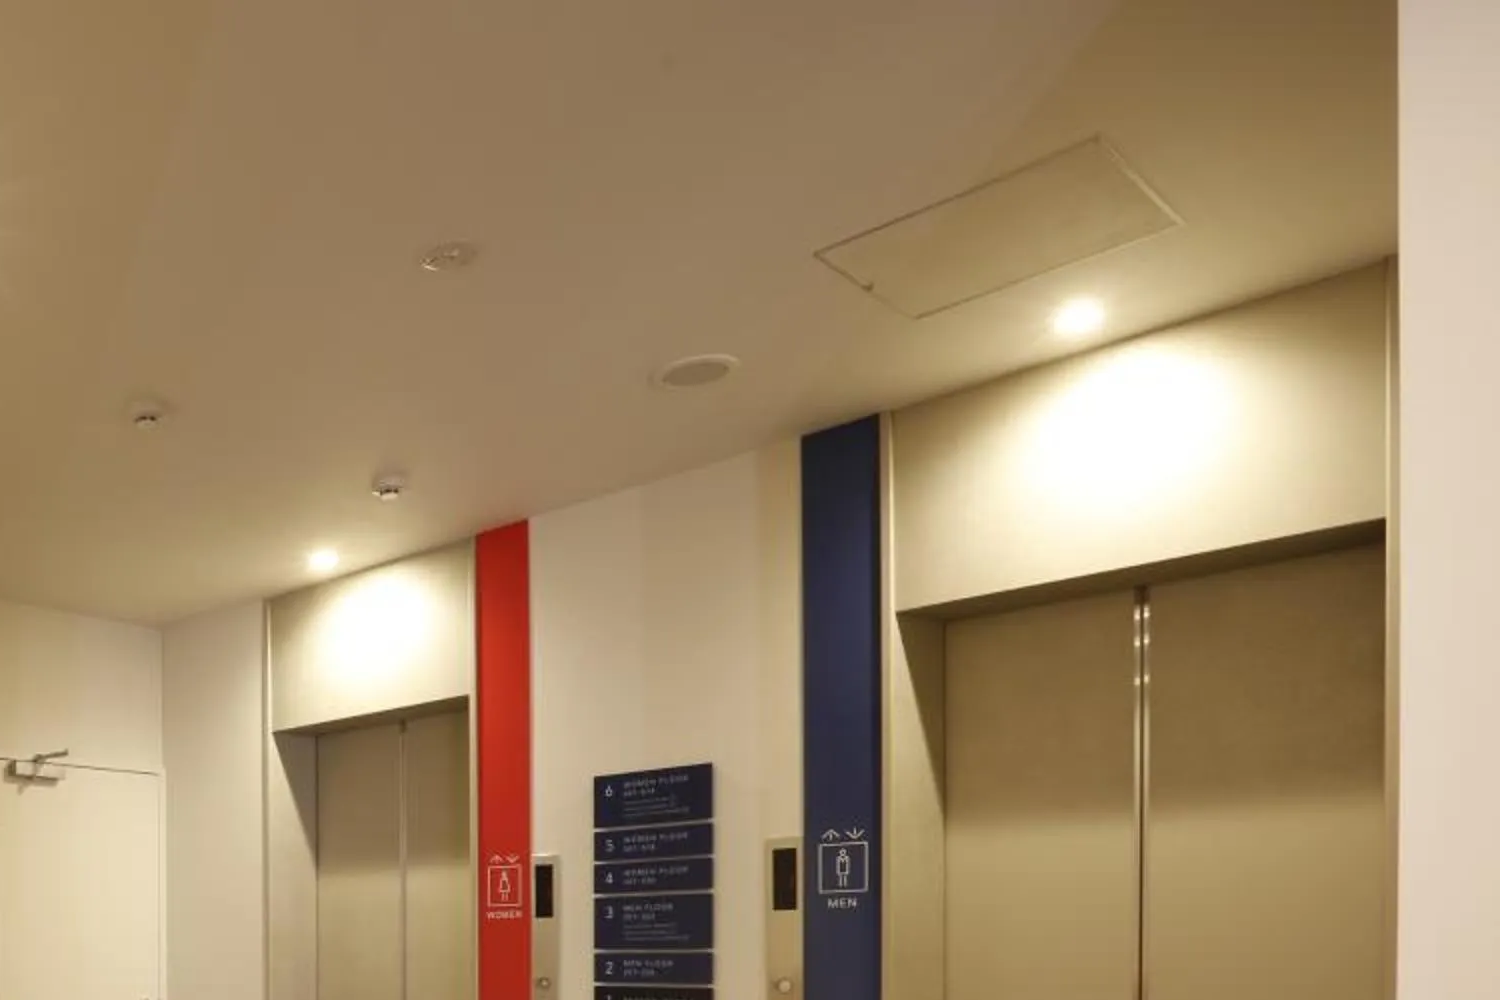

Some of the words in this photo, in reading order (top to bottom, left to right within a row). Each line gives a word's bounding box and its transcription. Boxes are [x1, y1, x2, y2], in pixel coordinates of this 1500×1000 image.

[605, 785, 613, 797] 6
[605, 839, 615, 852] 5
[605, 871, 613, 884] 4
[827, 897, 857, 909] MEN
[486, 911, 523, 919] WOMEN
[604, 905, 614, 919] 3
[605, 961, 614, 975] 2
